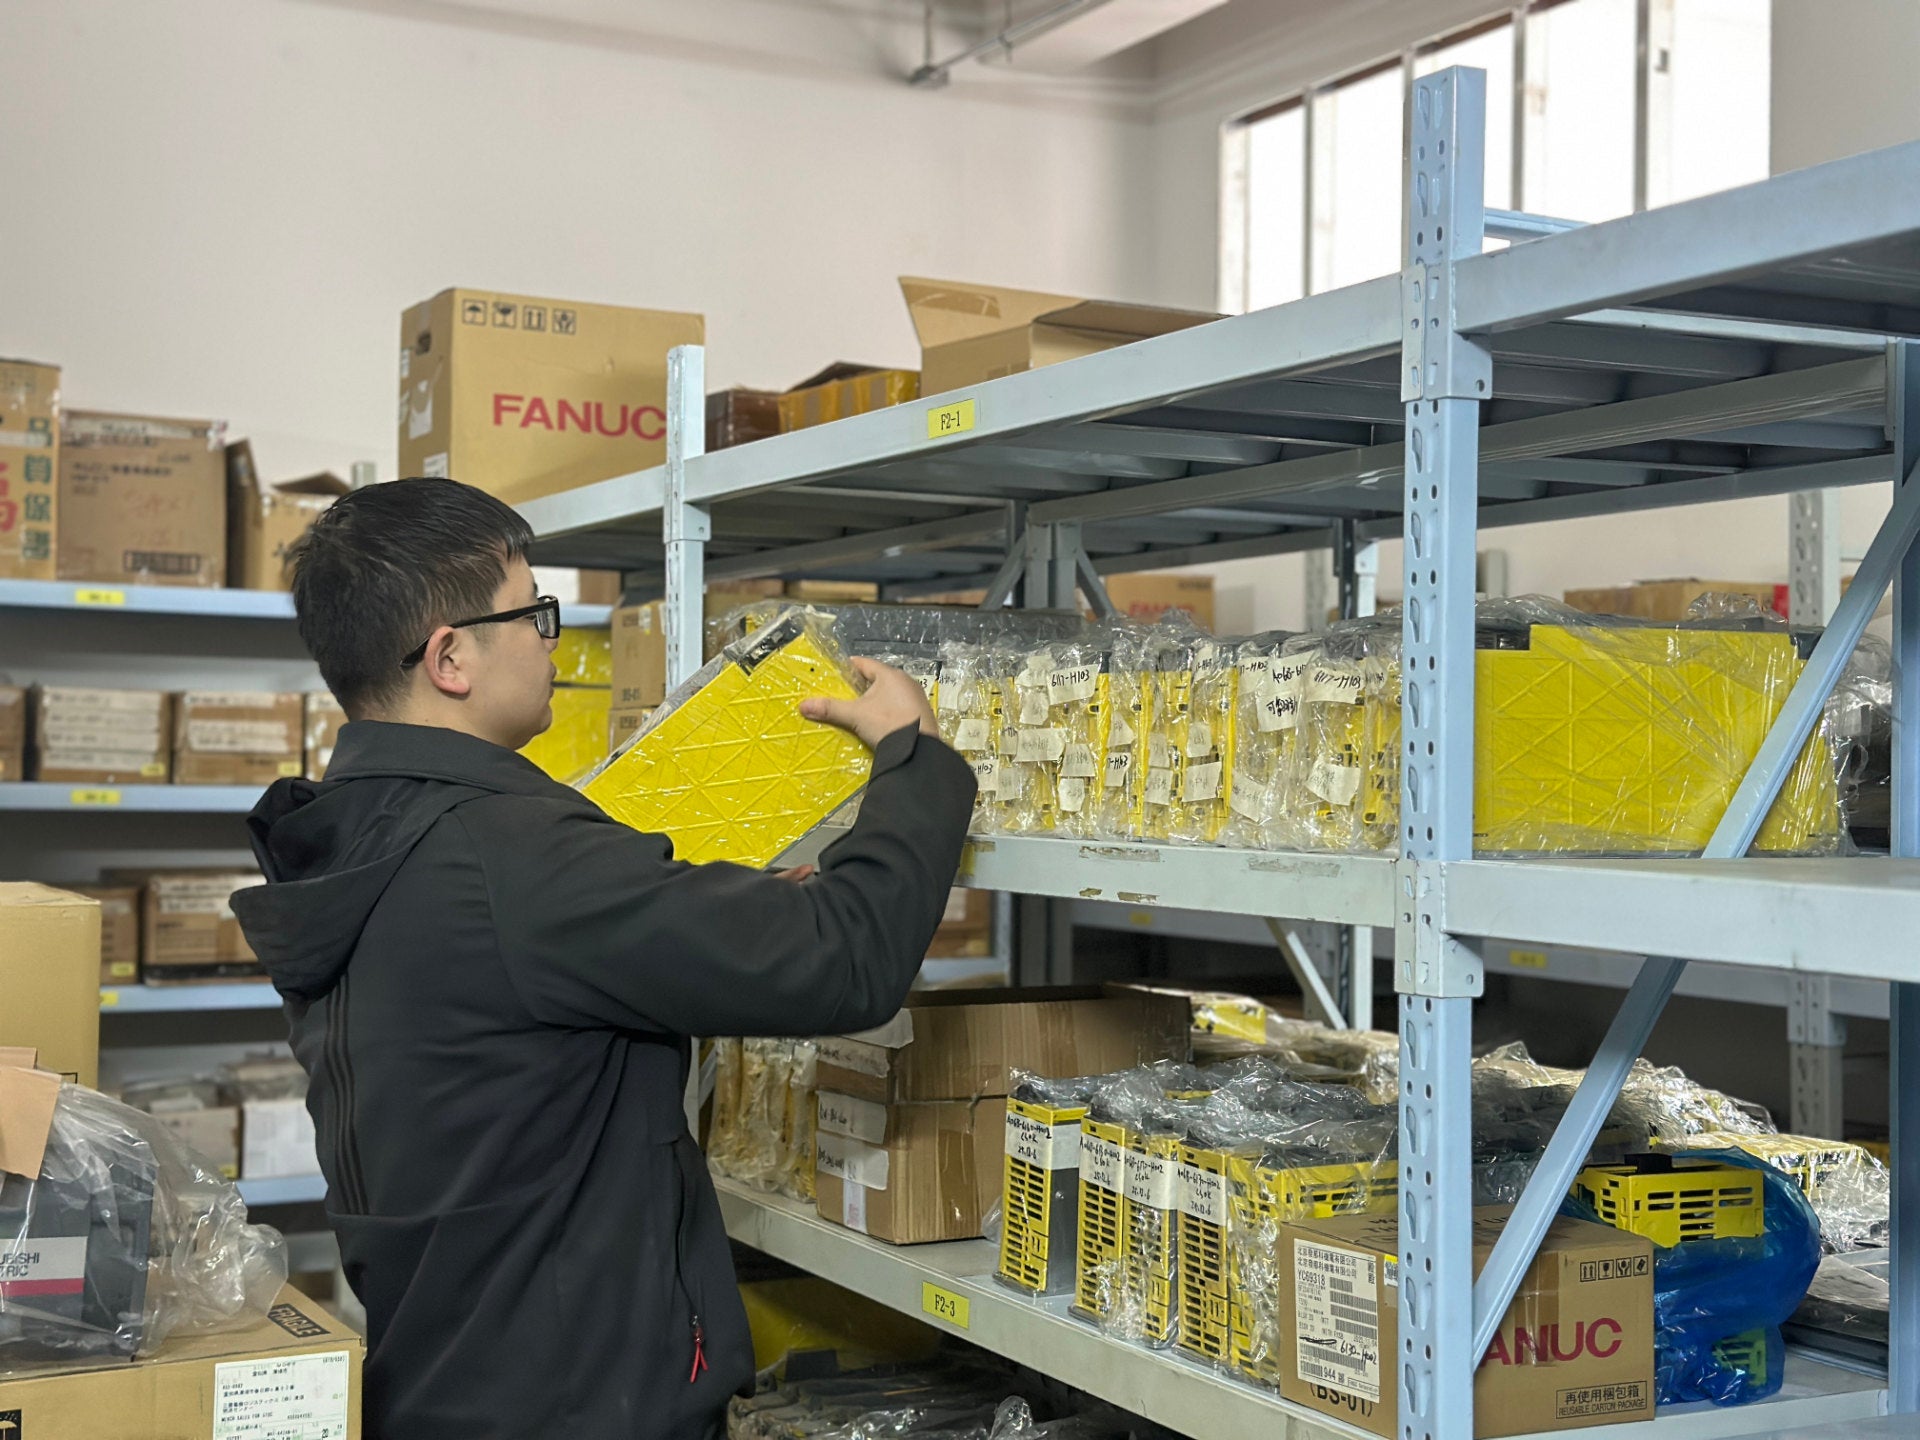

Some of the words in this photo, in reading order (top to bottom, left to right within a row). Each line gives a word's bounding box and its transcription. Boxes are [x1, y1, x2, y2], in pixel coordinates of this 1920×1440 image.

[493, 394, 667, 441] FANUC
[940, 410, 961, 431] F2-1
[934, 1293, 956, 1318] F2-3
[1565, 1384, 1640, 1405] 再使用梱包箱
[1559, 1404, 1590, 1416] REUSABLE
[1591, 1401, 1616, 1413] CARTON
